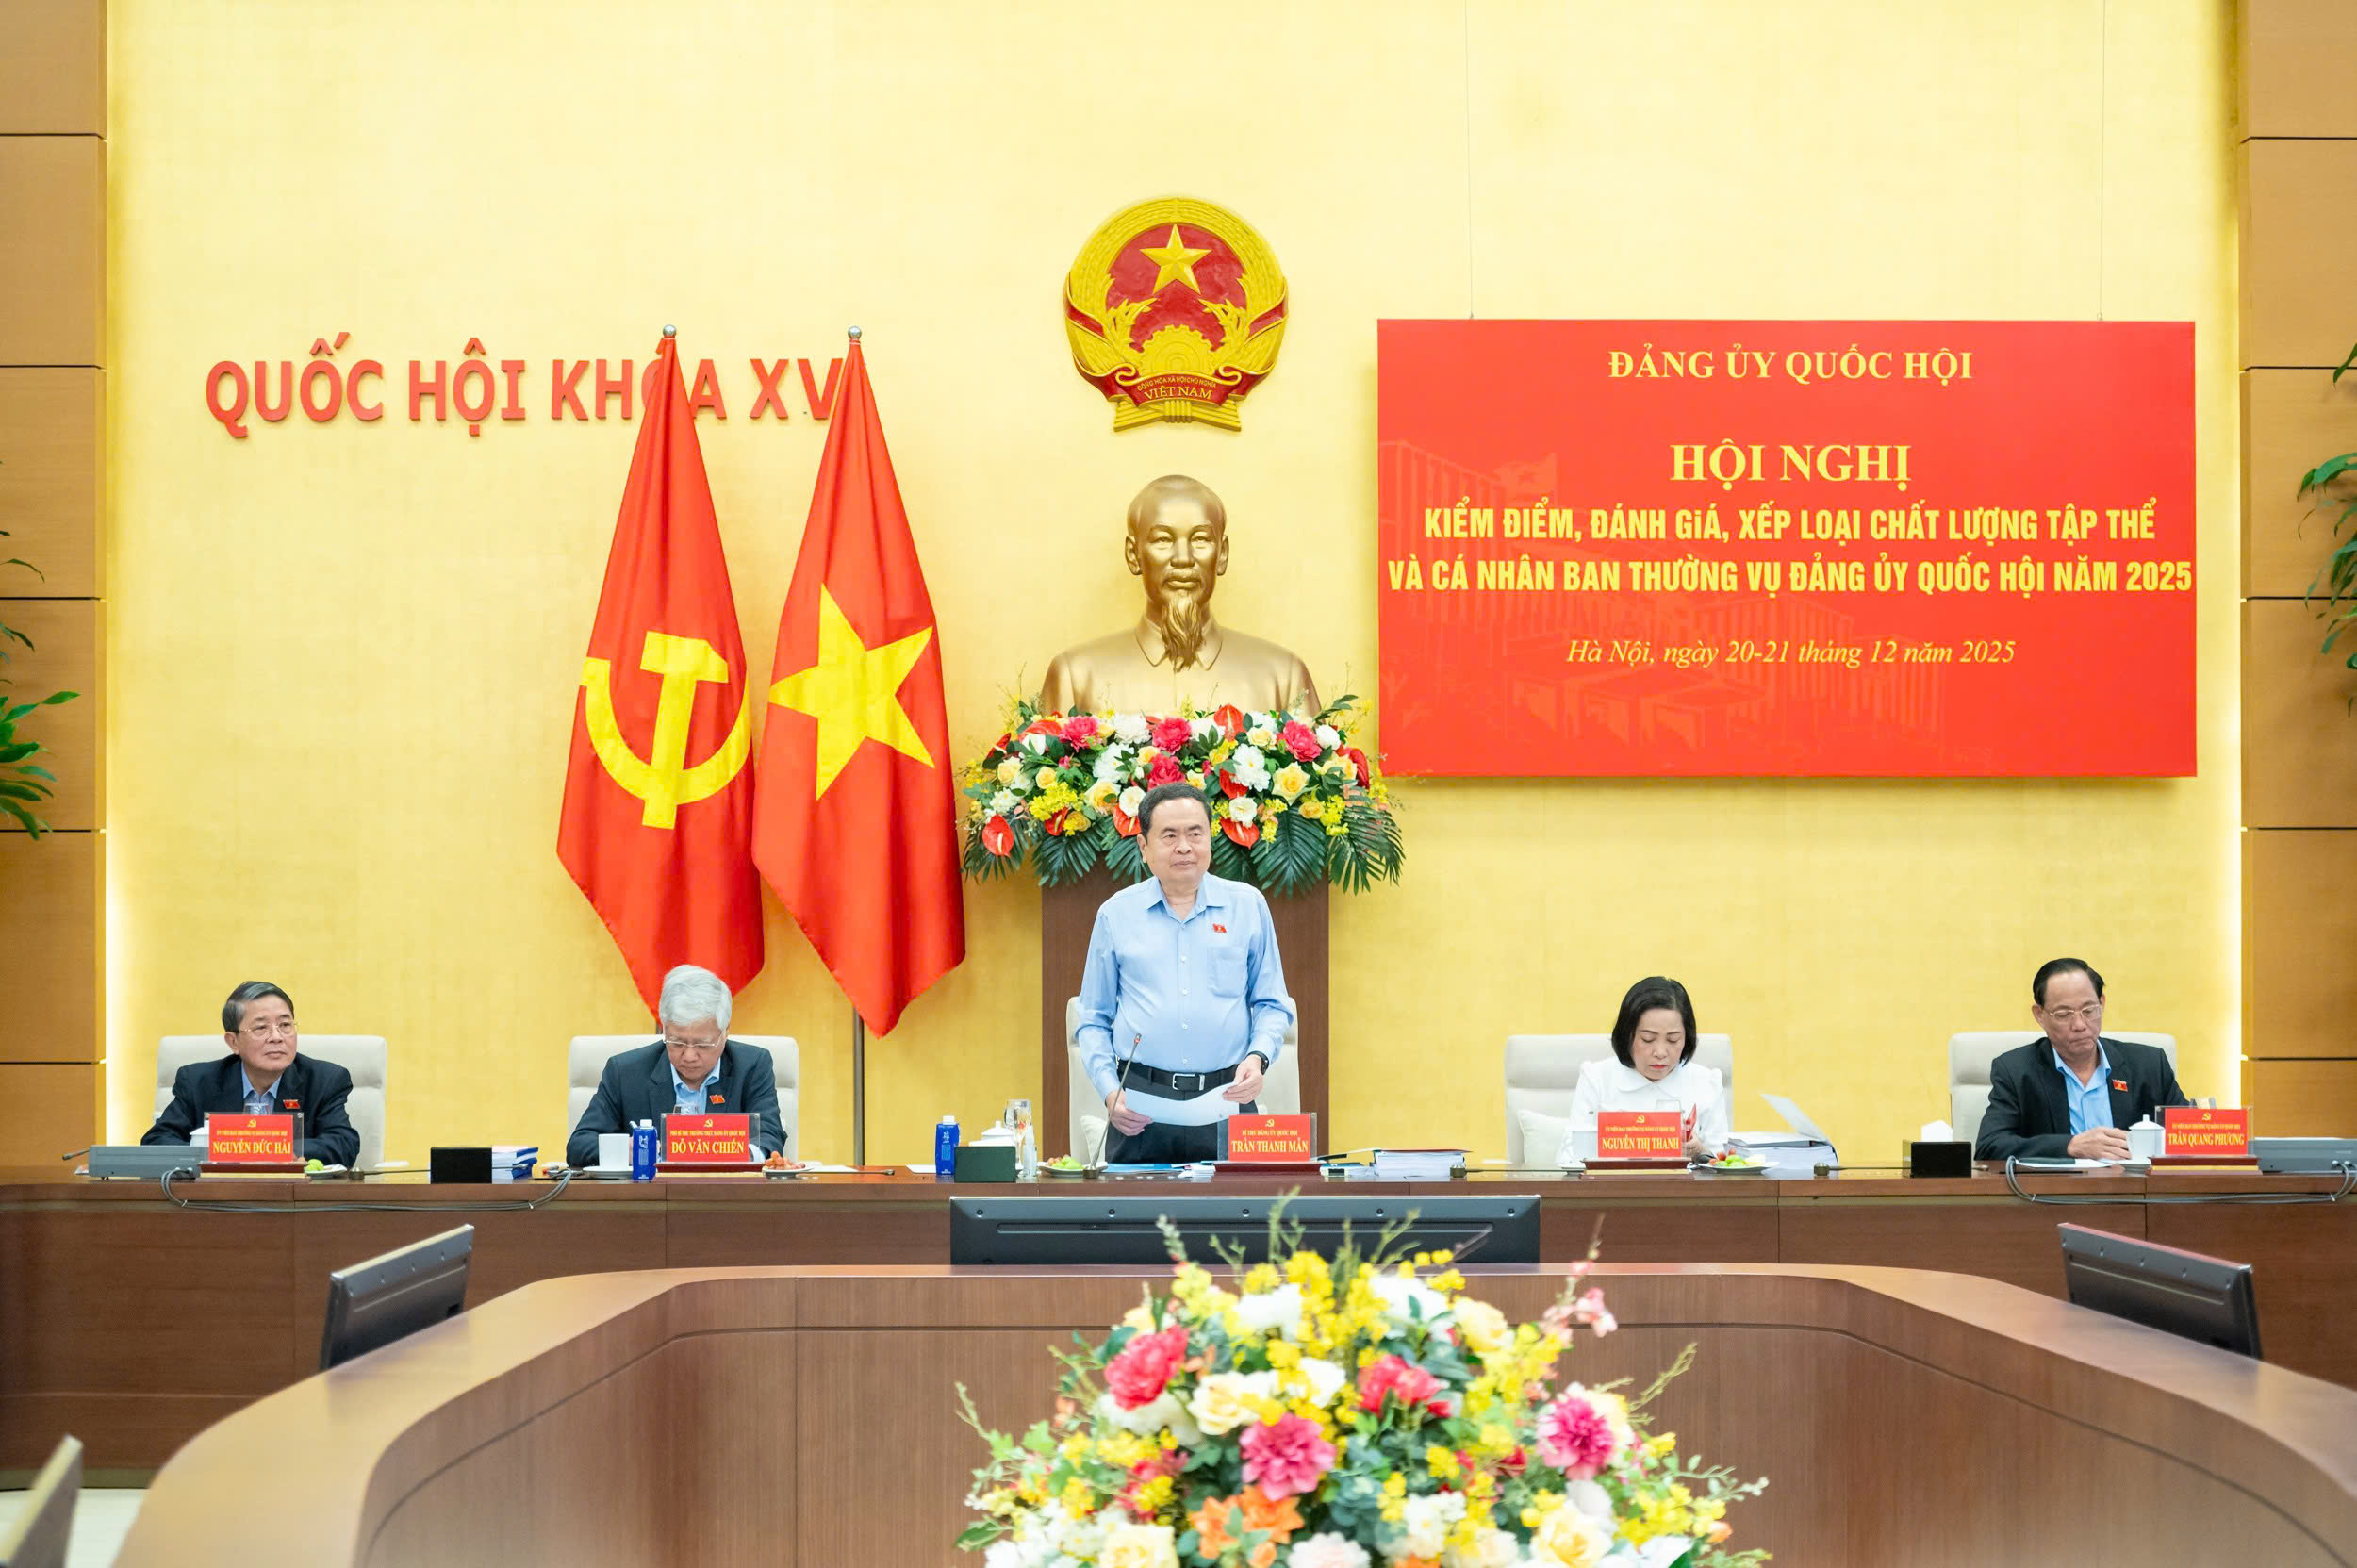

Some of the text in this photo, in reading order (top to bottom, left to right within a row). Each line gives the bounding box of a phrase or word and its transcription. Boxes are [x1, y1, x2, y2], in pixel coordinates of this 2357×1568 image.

[1608, 343, 1971, 386] ĐẢNG ỦY QUỐC HỘI
[206, 331, 383, 438] QUỐC
[409, 338, 526, 437] HỘI
[749, 357, 843, 420] XV
[1178, 386, 1213, 400] NAM
[1671, 438, 1910, 491] HỘI NGHỊ
[1426, 496, 1493, 538] KIỂM
[1503, 496, 1581, 542] ĐIỂM,
[1591, 503, 1666, 539] ĐÁNH
[1739, 501, 1791, 539] XẾP
[1801, 510, 1860, 546] LOẠI
[1871, 499, 1939, 539] CHẤT
[1949, 506, 2037, 546] LƯỢNG
[2046, 503, 2097, 546] TẬP
[2106, 497, 2156, 538] THỂ
[1388, 552, 2192, 598] VÀ CÁ NHÂN BAN THƯỜNG VỤ ĐẢNG ỦY QUỐC HỘI NĂM 2025
[1567, 640, 2015, 668] Hà Nội, ngày 20-21 tháng 12 năm 2025
[253, 1138, 272, 1154] ĐỨC
[274, 1138, 291, 1154] HẢI
[671, 1138, 744, 1154] ĐỖ VĂN CHIẾN
[1231, 1136, 1255, 1152] TRẦN
[1256, 1140, 1286, 1152] THANH
[1636, 1137, 1650, 1153] THỊ
[1652, 1137, 1679, 1149] THANH
[2188, 1133, 2213, 1147] QUANG
